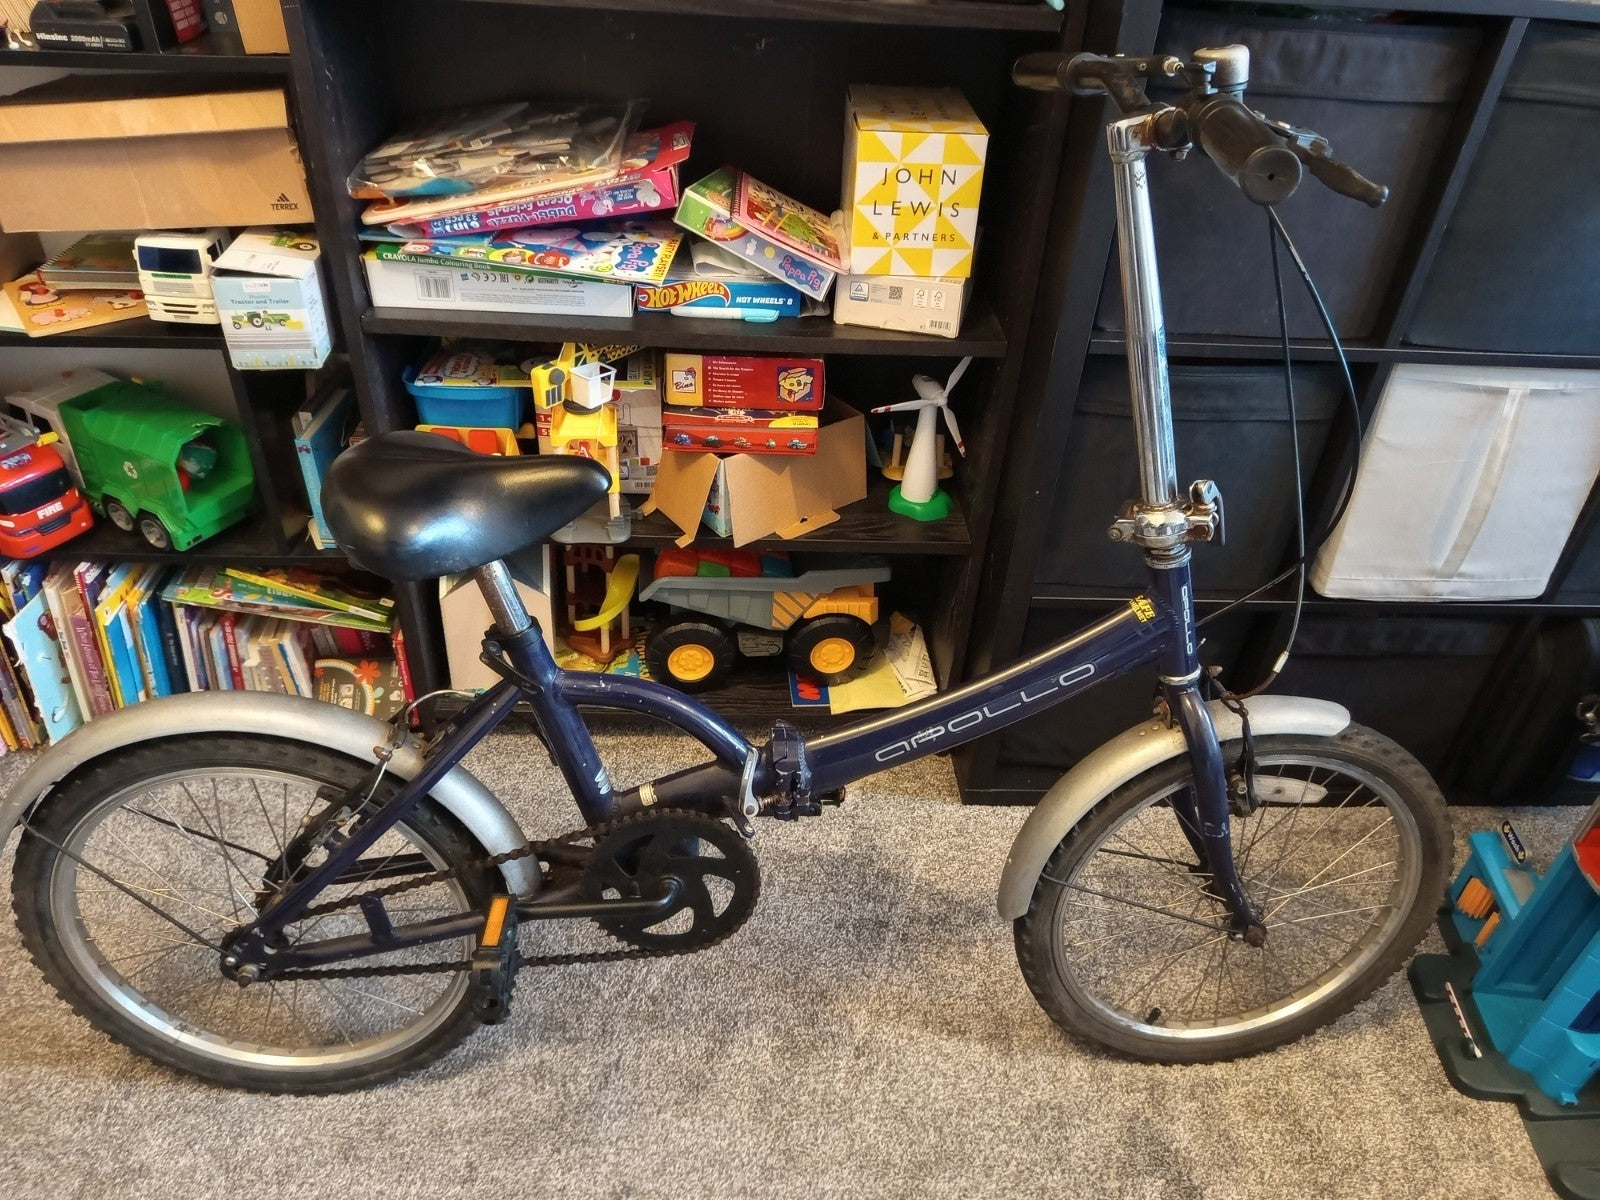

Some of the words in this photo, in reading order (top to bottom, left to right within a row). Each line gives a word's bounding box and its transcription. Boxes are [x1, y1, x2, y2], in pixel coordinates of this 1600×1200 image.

[882, 168, 956, 186] JOHN
[270, 203, 299, 211] TERREX
[873, 200, 960, 218] LEWIS
[872, 232, 879, 240] &
[885, 232, 956, 241] PARTNERS
[382, 252, 416, 263] CRAYOLA
[417, 256, 439, 265] Jumbo
[440, 259, 474, 270] Colouring
[474, 262, 491, 270] Book
[782, 256, 806, 281] Peppa
[808, 270, 820, 289] Pig
[735, 296, 752, 304] HOT
[36, 501, 64, 520] FIRE
[1181, 585, 1193, 655] APOLLO
[874, 663, 1096, 763] APOLLO
